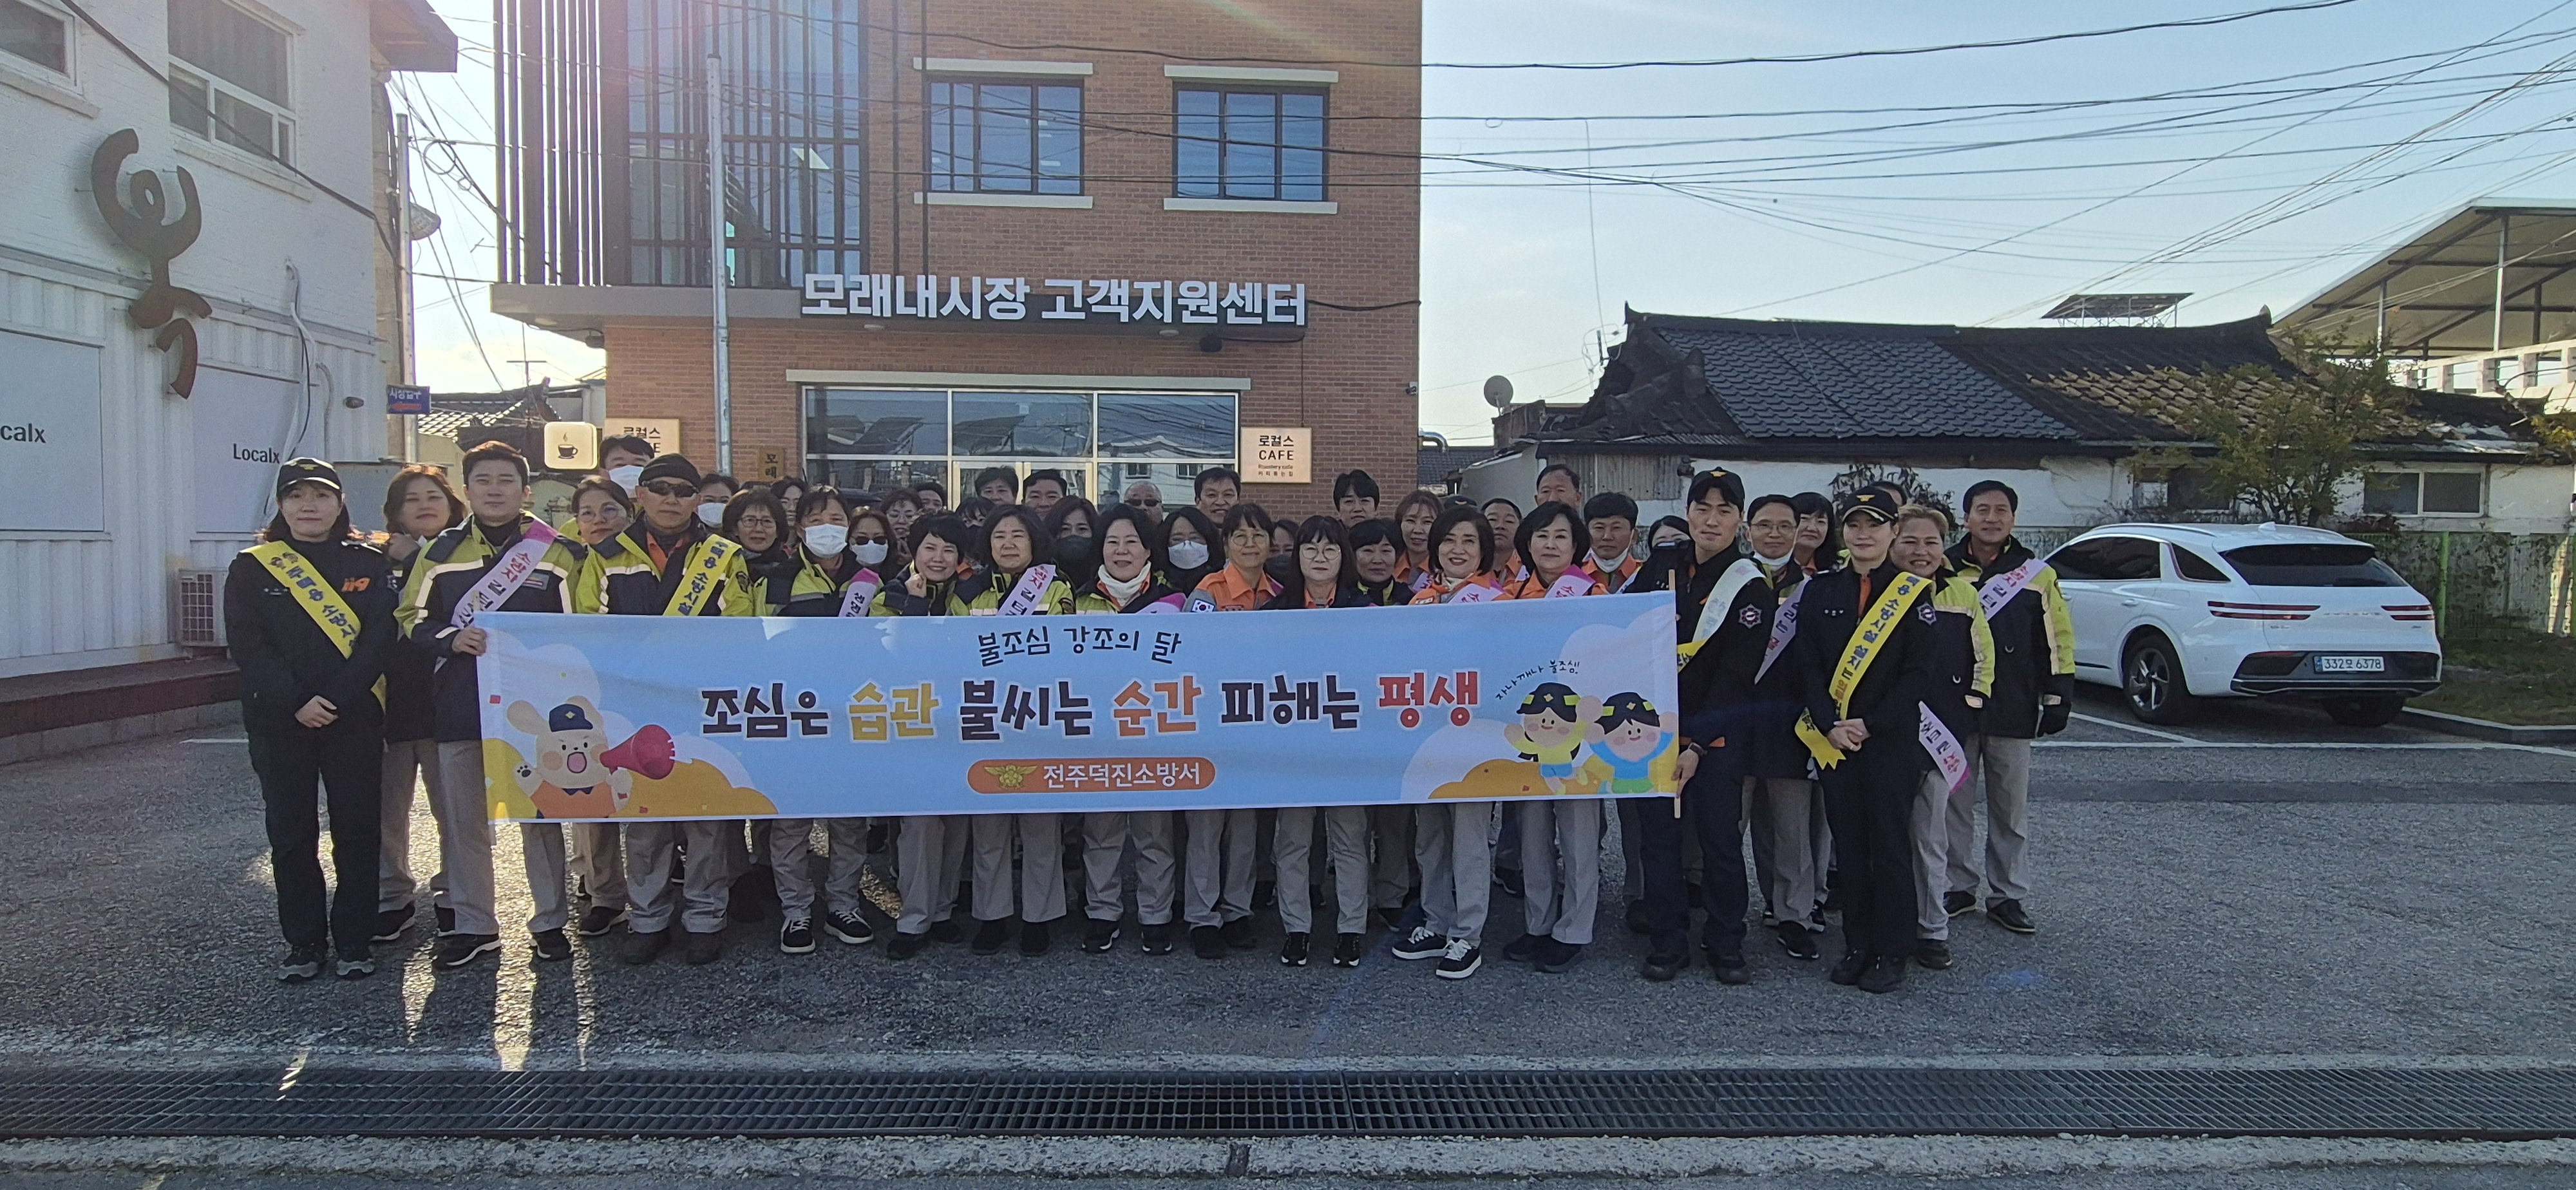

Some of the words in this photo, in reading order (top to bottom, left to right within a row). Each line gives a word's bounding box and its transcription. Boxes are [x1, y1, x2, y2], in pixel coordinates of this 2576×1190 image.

[801, 273, 1027, 322] 모래내시장
[1041, 277, 1307, 326] 고객지원센터
[232, 443, 281, 464] Localx
[1258, 435, 1294, 446] 로컬스
[1259, 450, 1294, 460] CAFE
[978, 626, 1050, 667] 불조심
[1063, 625, 1139, 654] 강조의
[1151, 631, 1182, 665] 달
[1495, 665, 1544, 700] 자나깨나
[701, 682, 829, 738] 조심은
[849, 682, 938, 740] 습관
[961, 680, 1091, 740] 불씨는
[1113, 675, 1203, 736] 순간
[1221, 675, 1359, 729] 피해는
[1378, 672, 1479, 727] 평생
[1043, 762, 1200, 788] 전주덕진소방서
